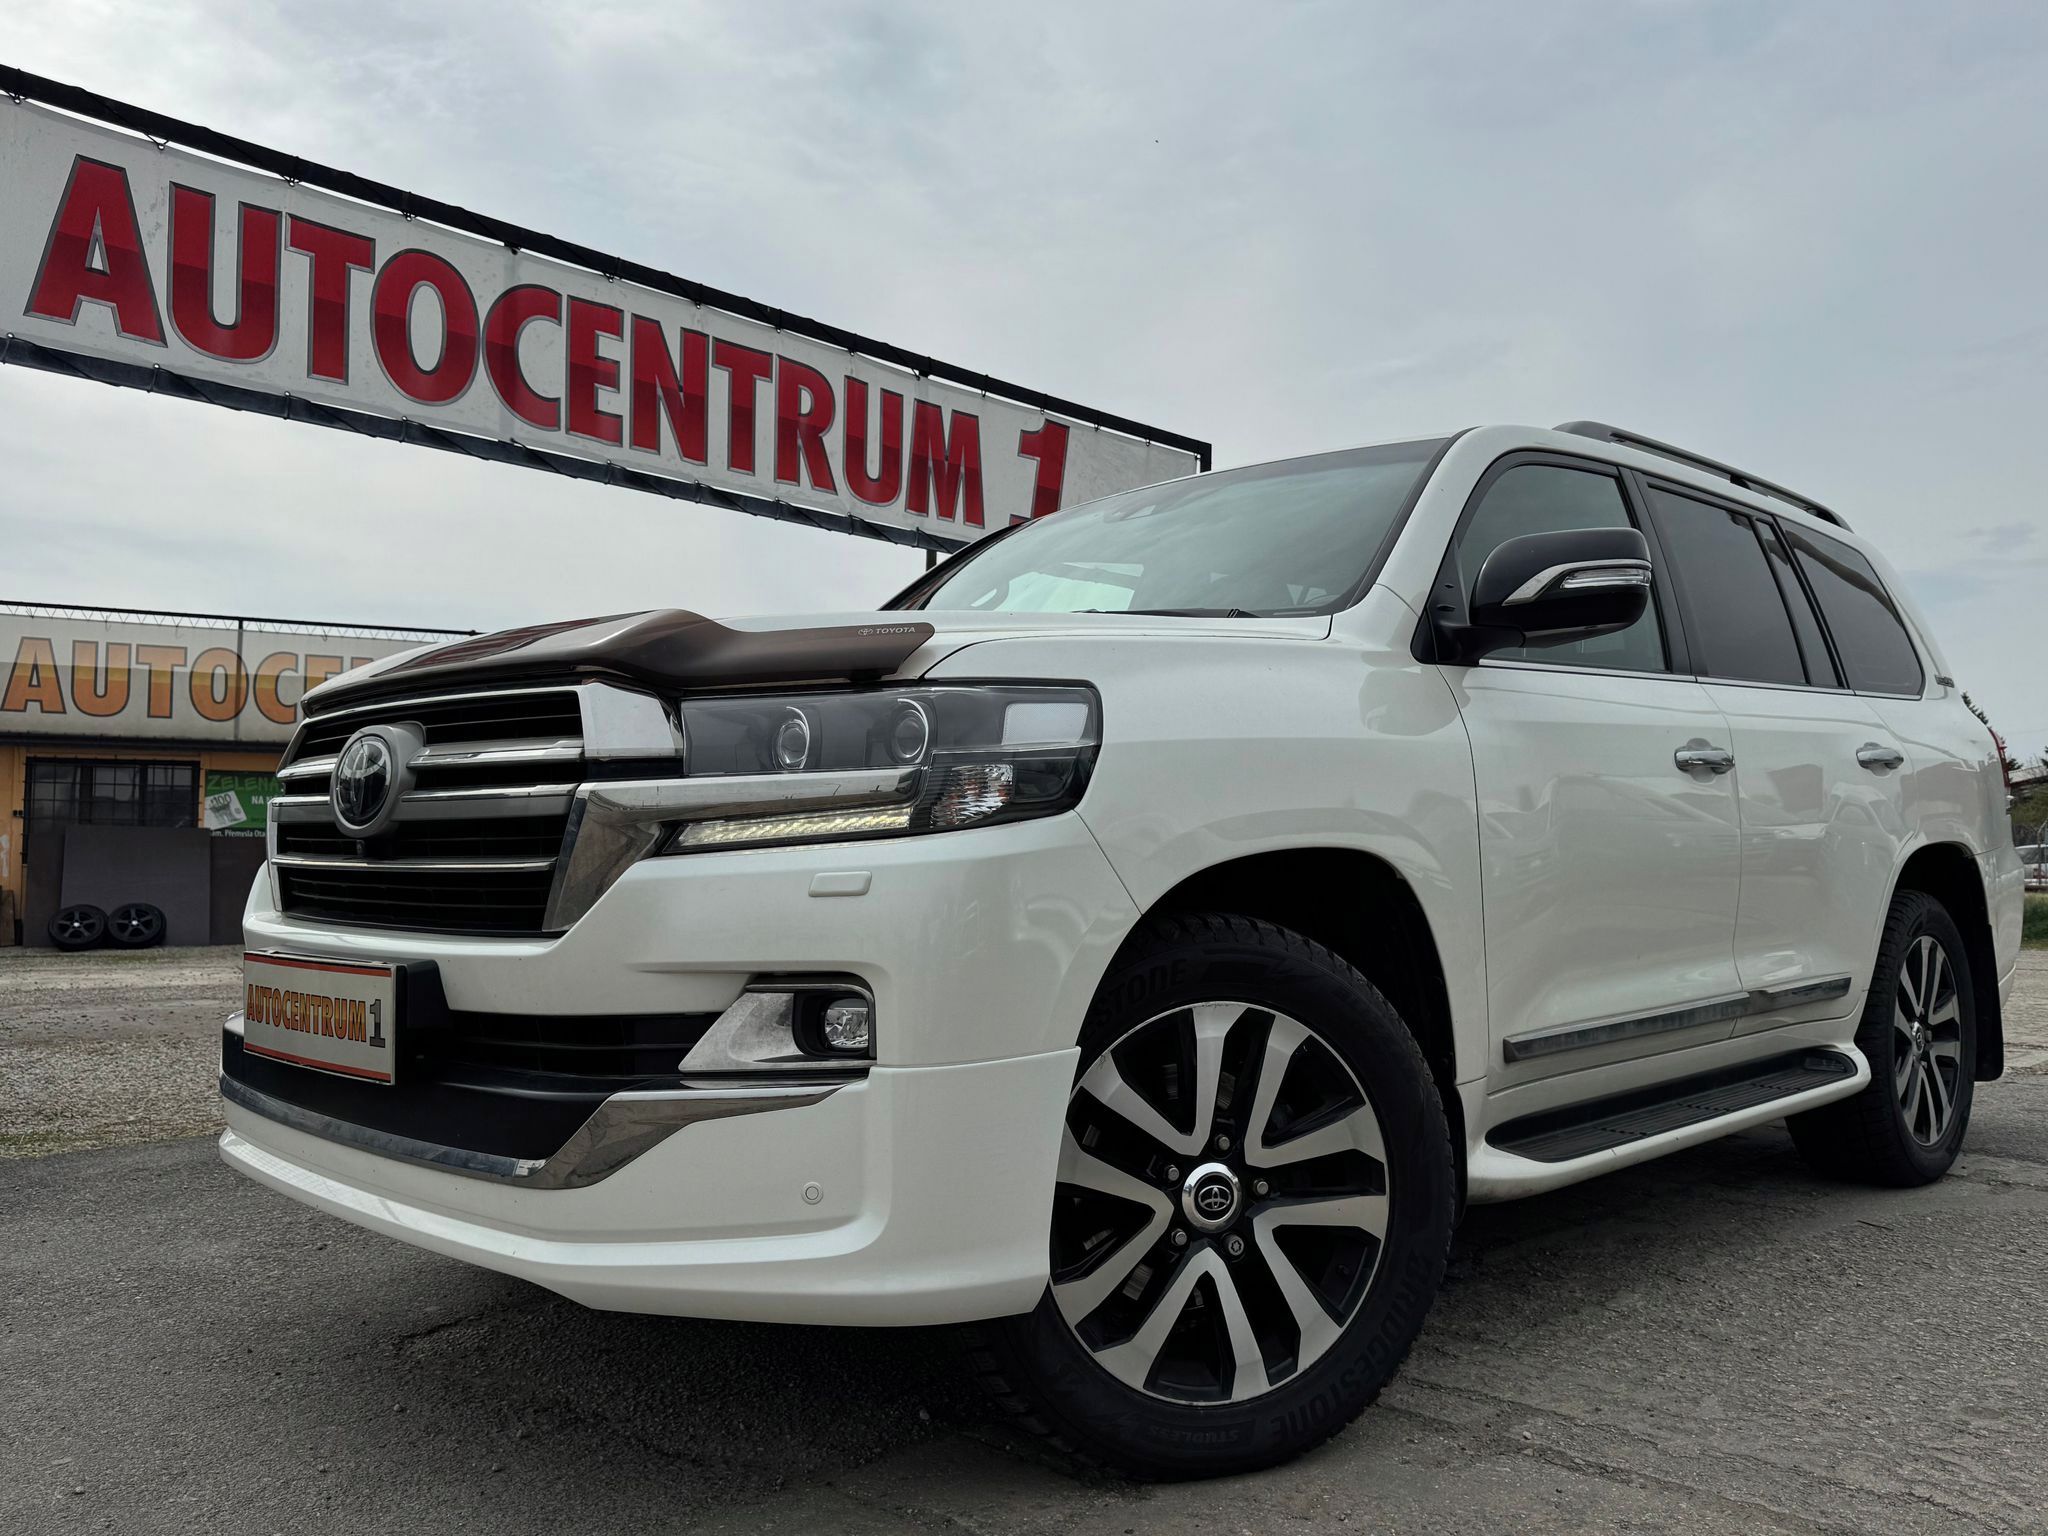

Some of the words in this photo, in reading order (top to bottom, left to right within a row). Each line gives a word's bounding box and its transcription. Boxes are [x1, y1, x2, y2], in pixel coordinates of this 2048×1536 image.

[23, 154, 985, 529] AUTOCENTRUM
[1009, 417, 1070, 525] 1
[876, 626, 916, 634] TOYOTA
[1269, 1248, 1436, 1441] BRIDGESTONE
